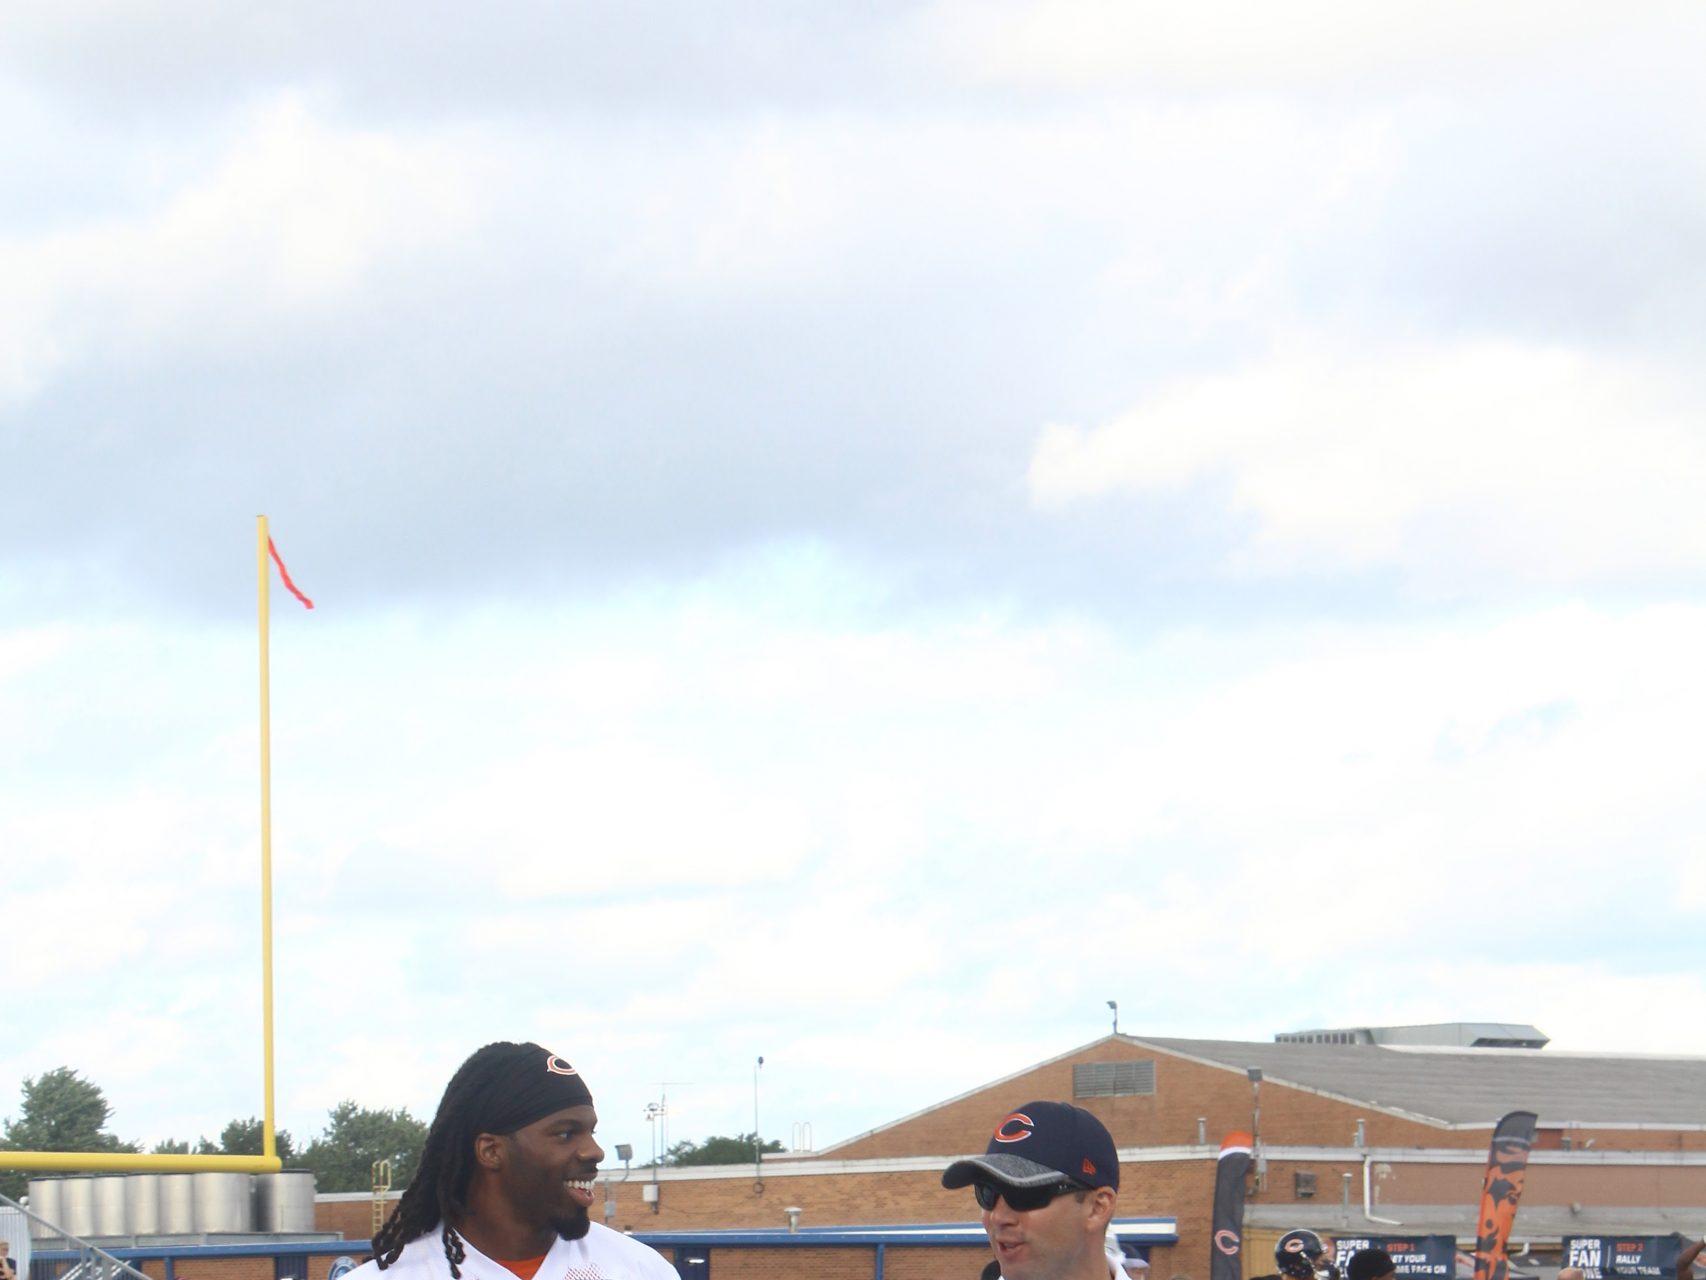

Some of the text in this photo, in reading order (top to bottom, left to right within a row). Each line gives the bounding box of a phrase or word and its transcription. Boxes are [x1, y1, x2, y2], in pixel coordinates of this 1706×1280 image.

[994, 1112, 1034, 1142] C
[1215, 1230, 1240, 1255] C
[1285, 1239, 1304, 1253] C
[1336, 1239, 1369, 1250] SUPER
[1570, 1239, 1601, 1249] SUPER
[1404, 1254, 1426, 1263] YOUR
[1570, 1250, 1601, 1267] FAN
[1615, 1255, 1641, 1264] RALLY
[1434, 1265, 1447, 1274] ON
